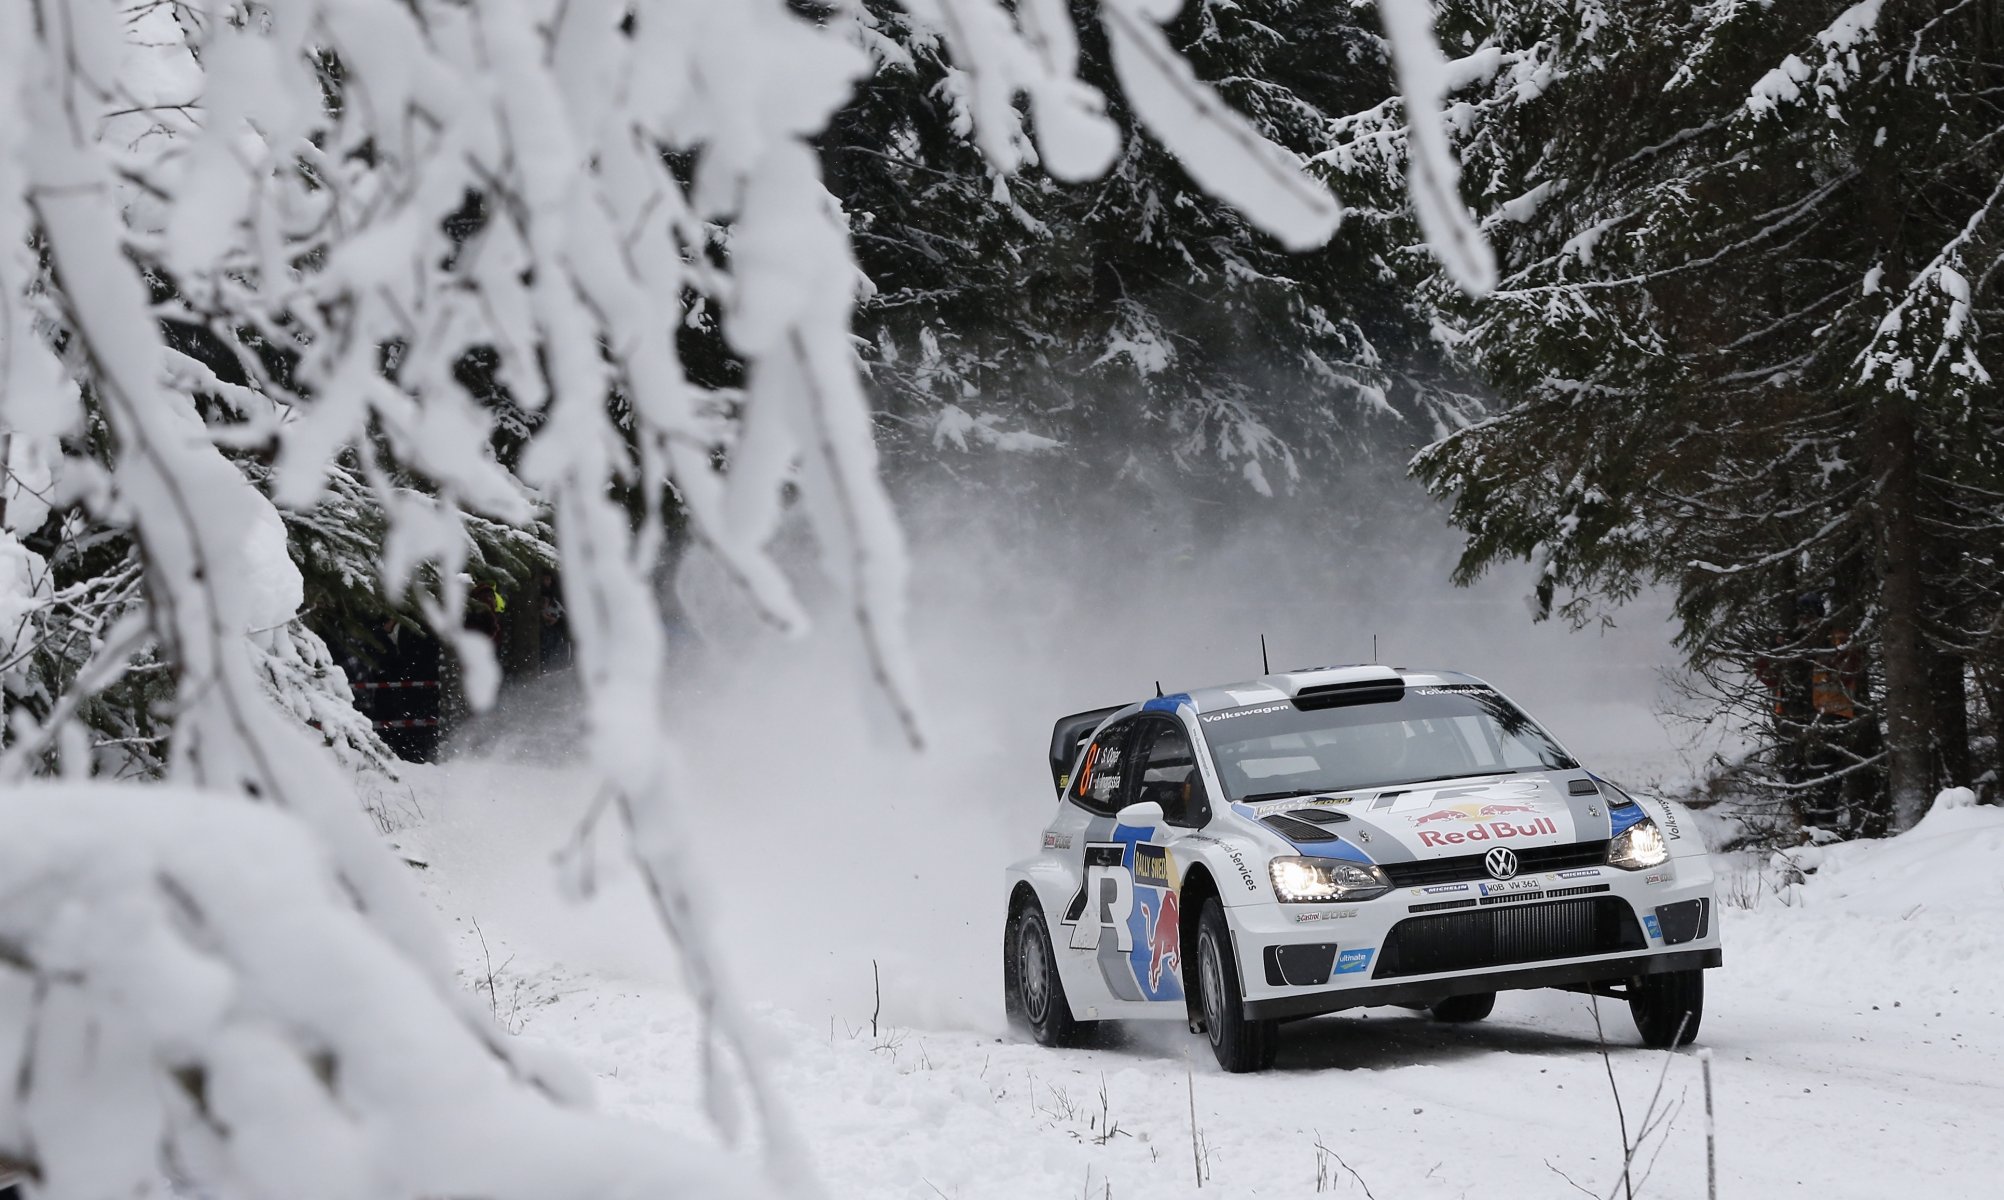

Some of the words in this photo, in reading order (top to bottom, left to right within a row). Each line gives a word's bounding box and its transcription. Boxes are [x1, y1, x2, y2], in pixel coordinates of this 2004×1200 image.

[1414, 686, 1498, 698] Volkswagen
[1203, 704, 1288, 722] Volkswagen
[1080, 743, 1098, 796] 8
[1418, 824, 1490, 847] Red
[1490, 817, 1558, 839] Bull
[1136, 851, 1150, 877] RALLY
[1230, 852, 1257, 891] Services
[1562, 869, 1600, 879] MICHELIN
[1428, 884, 1468, 894] MICHELIN
[1487, 884, 1505, 893] WOB
[1508, 882, 1521, 890] VW
[1521, 880, 1538, 888] 361
[1069, 864, 1134, 953] R
[1300, 912, 1320, 922] Castrol
[1321, 908, 1359, 920] EDGE
[1339, 953, 1367, 962] ultimate
